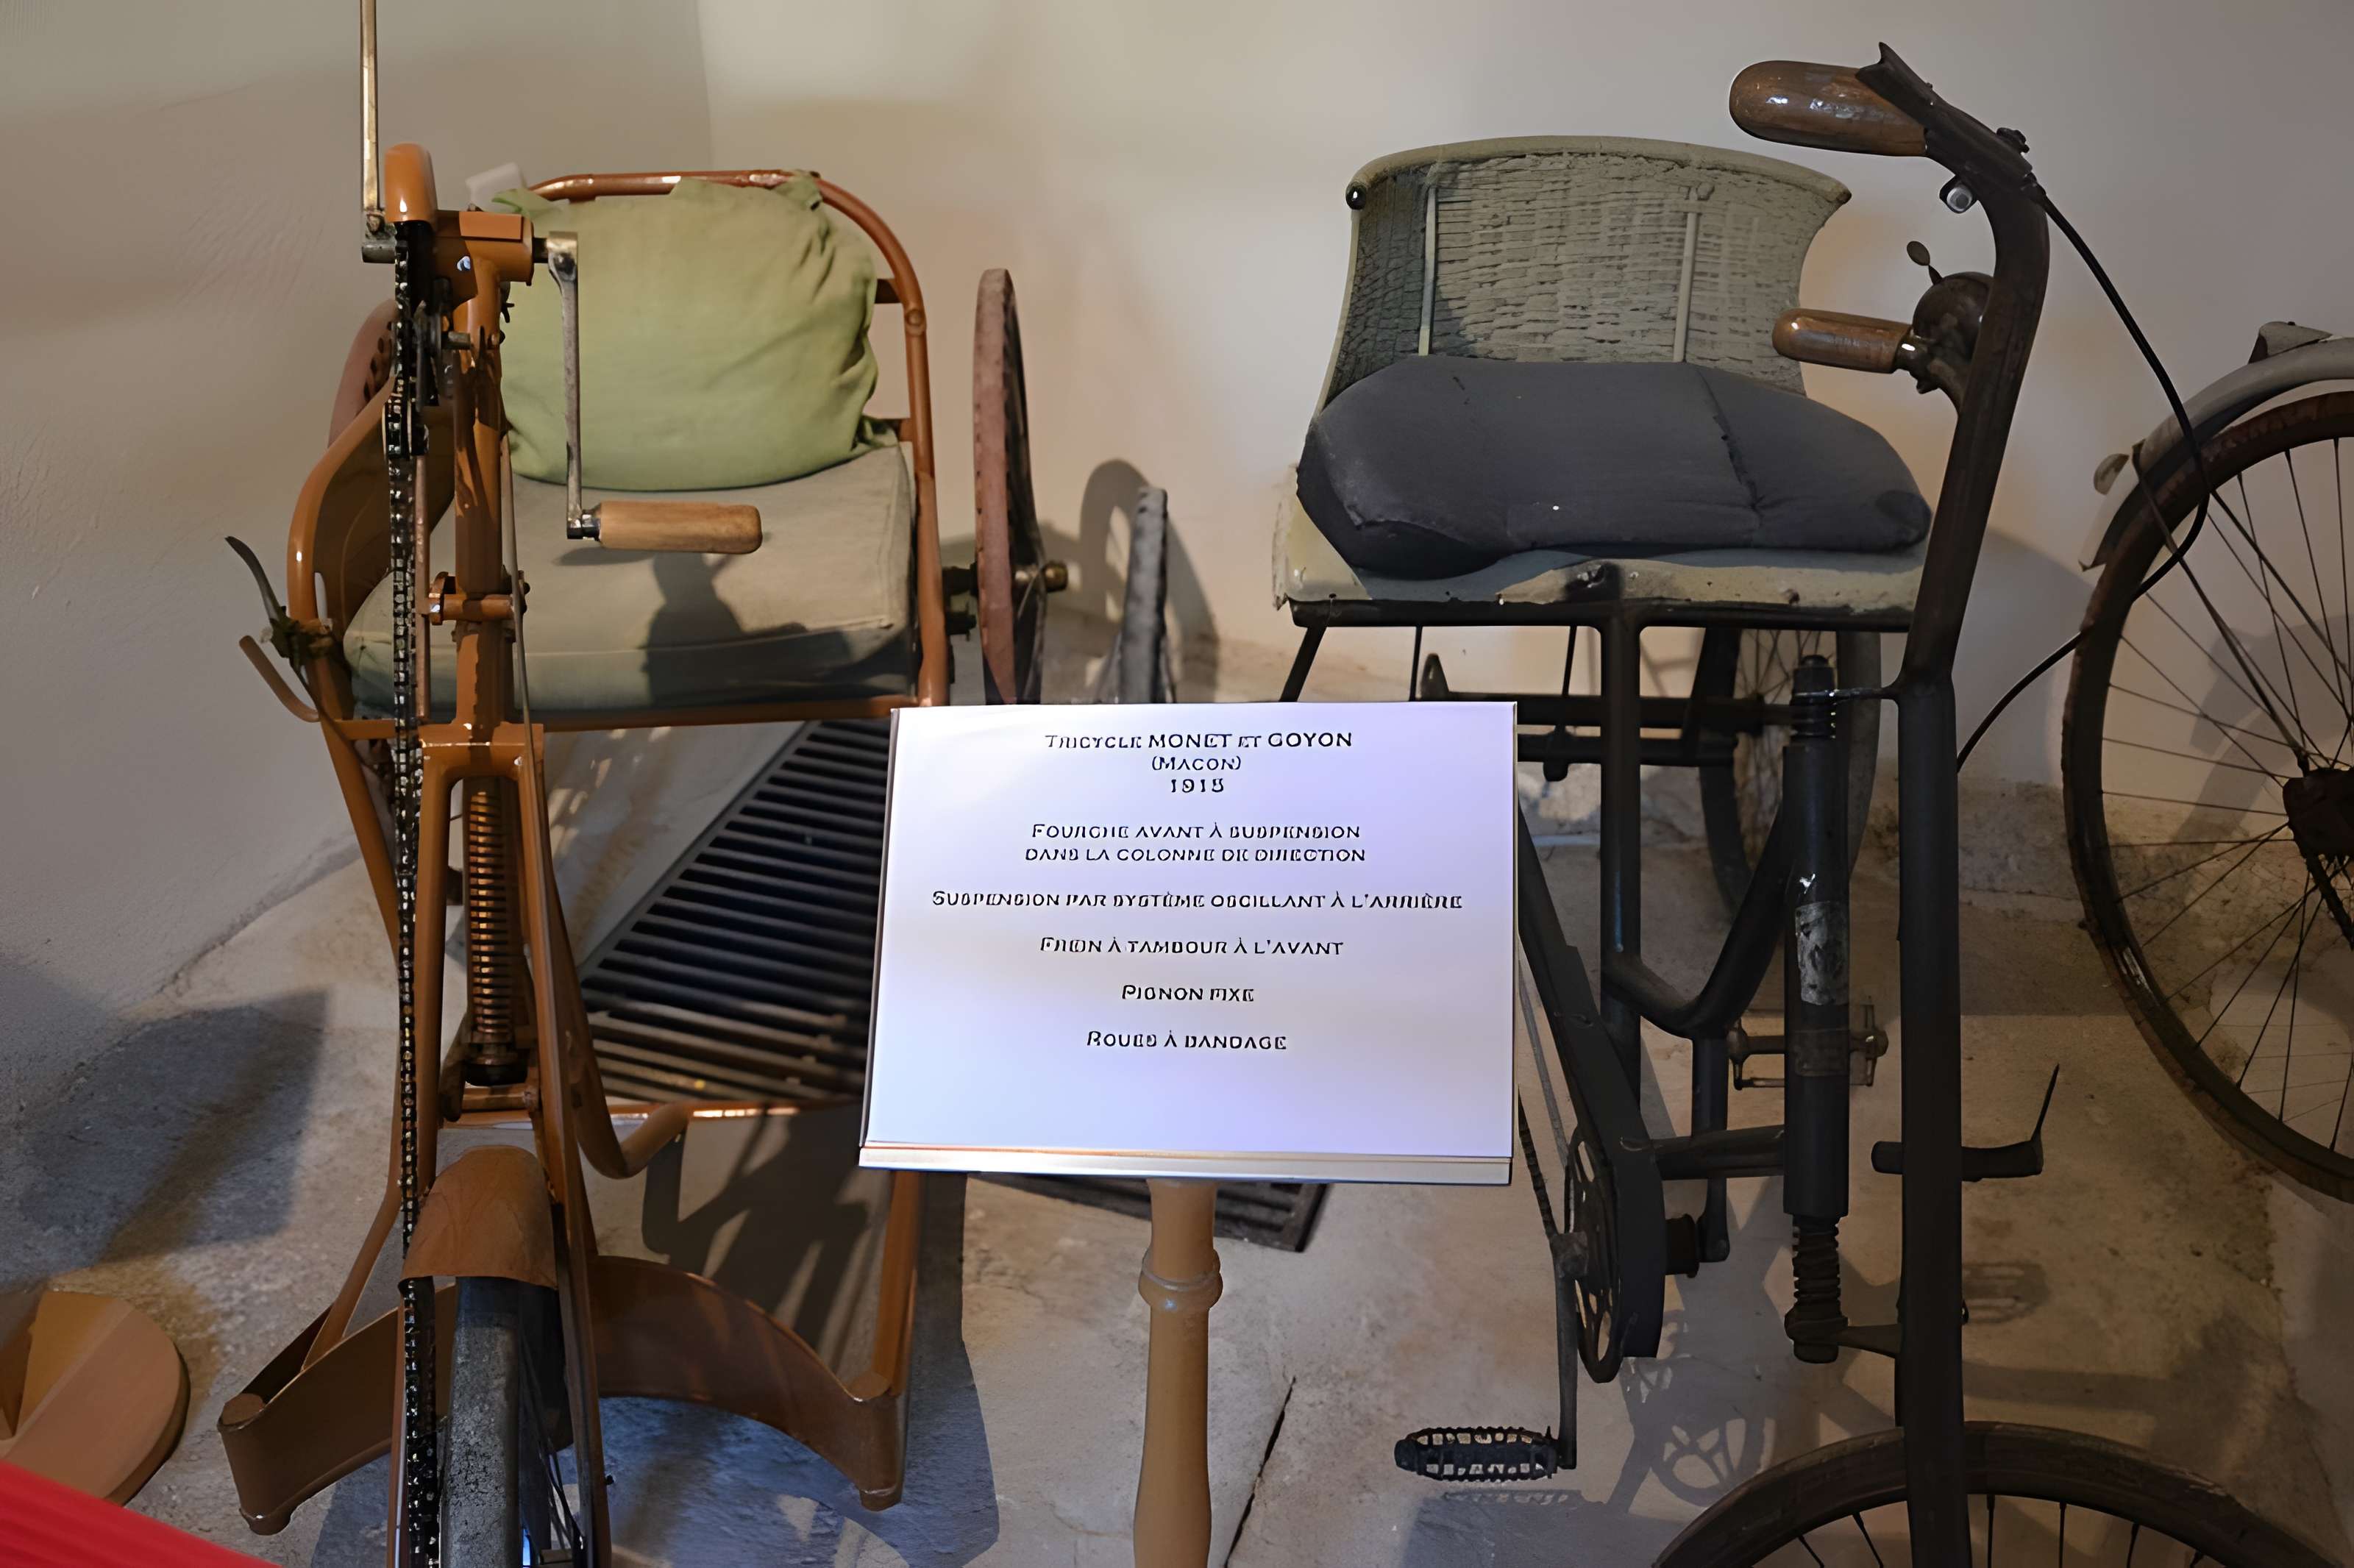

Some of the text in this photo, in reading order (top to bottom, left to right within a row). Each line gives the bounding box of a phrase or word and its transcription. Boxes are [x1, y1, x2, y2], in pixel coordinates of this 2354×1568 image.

[1044, 732, 1352, 749] TRICYCLE MONET ET GOYON
[1031, 822, 1360, 839] FOURCHE AVANT À SUSPENSION
[1025, 848, 1365, 863] DANS LA COLONNE DE DIRECTION
[932, 890, 1060, 907] SUSPENSION
[1065, 894, 1107, 907] PAR
[1210, 894, 1326, 908] OSCILLANT
[1330, 890, 1345, 908] À
[1107, 936, 1122, 953] À
[1127, 941, 1228, 955] TAMBOUR
[1233, 936, 1248, 955] À
[1254, 939, 1344, 955] L'AVANT
[1121, 984, 1254, 1002] PIGNON FIXE
[1087, 1030, 1287, 1050] ROUES À BANDAGE
